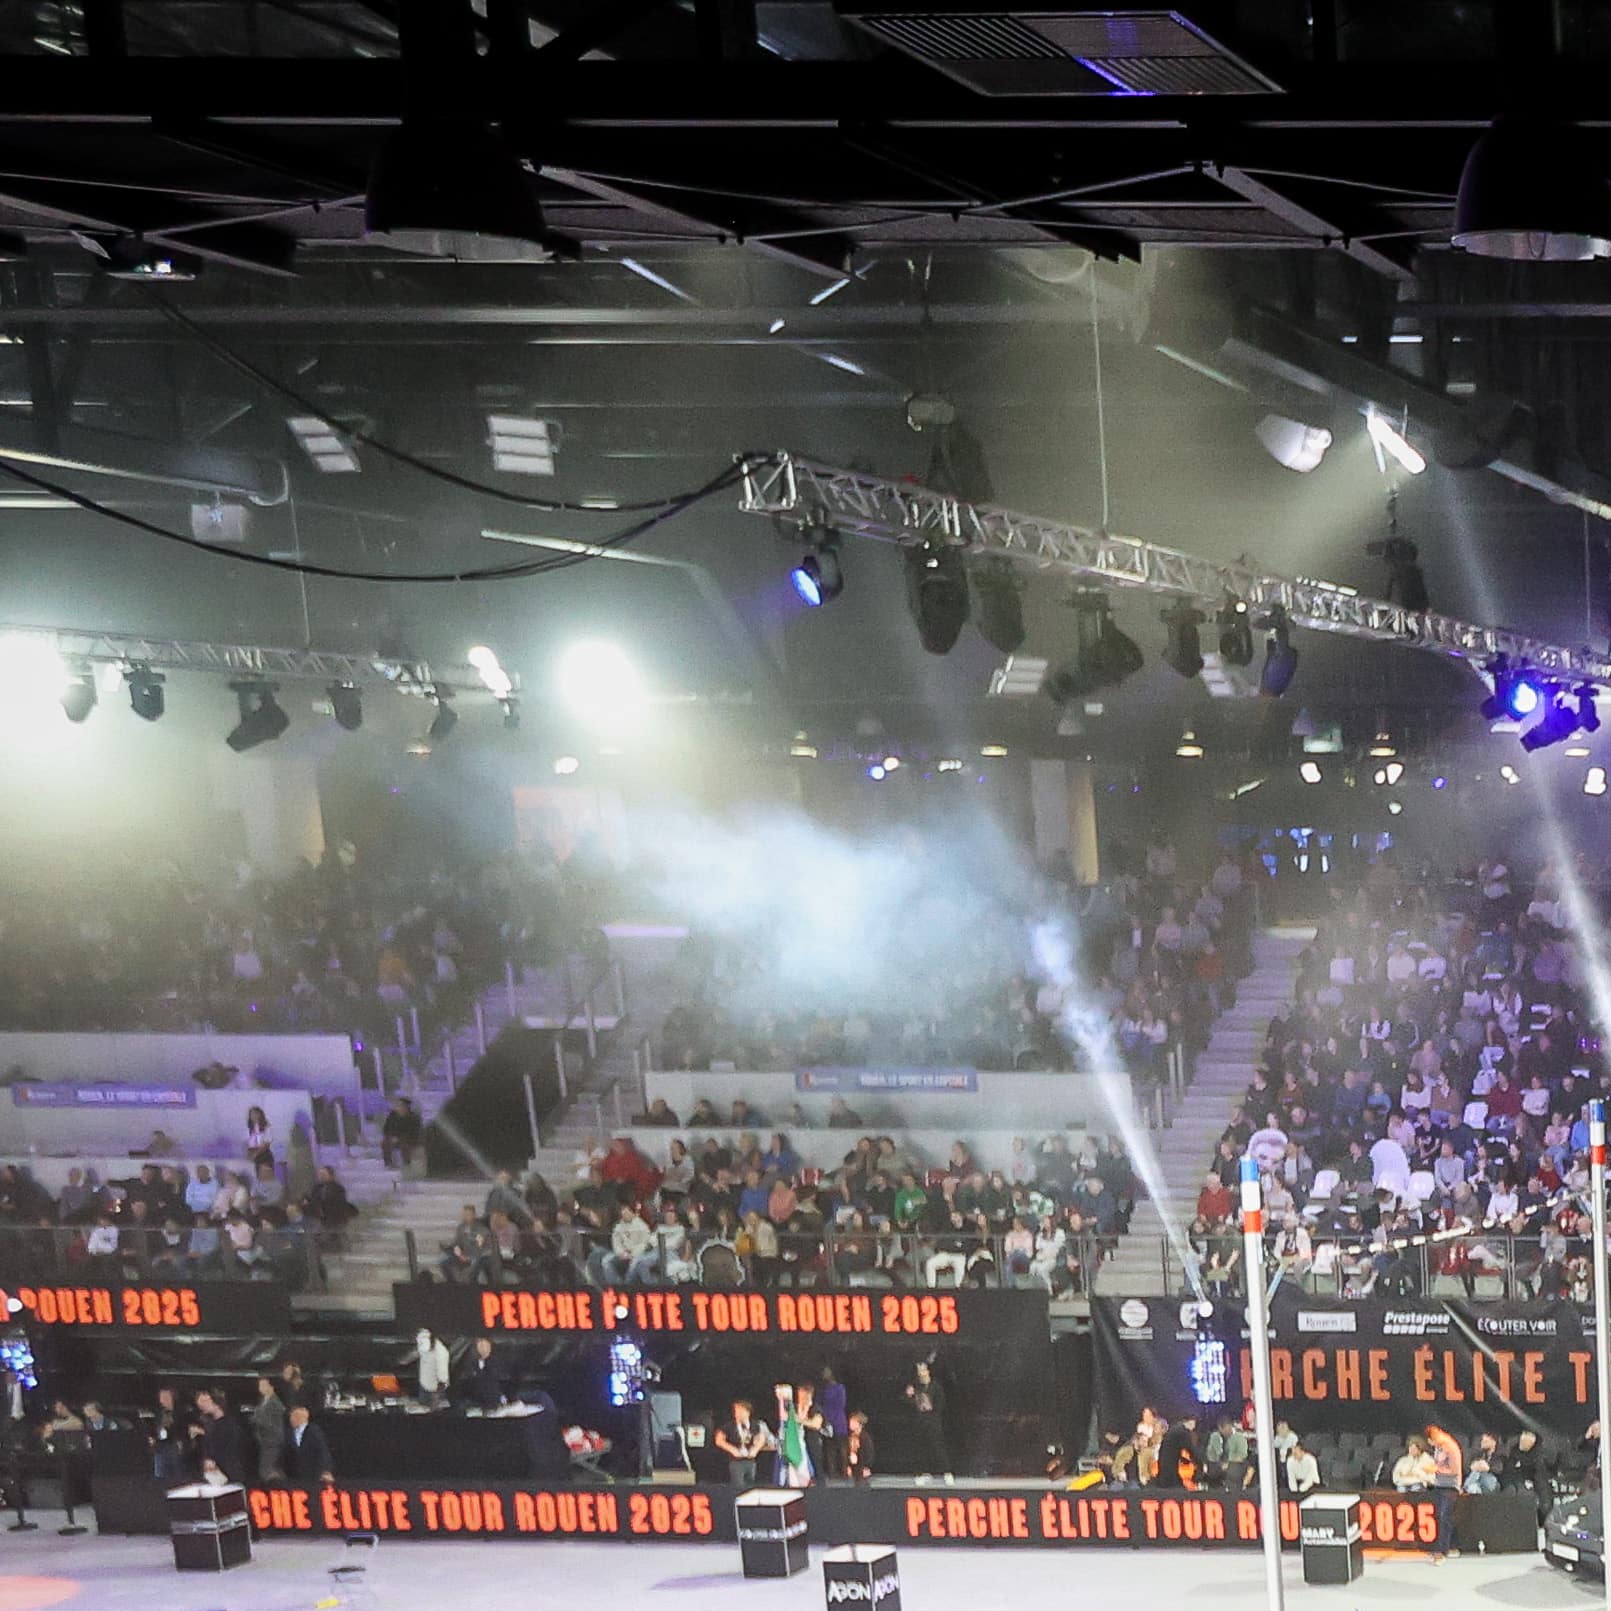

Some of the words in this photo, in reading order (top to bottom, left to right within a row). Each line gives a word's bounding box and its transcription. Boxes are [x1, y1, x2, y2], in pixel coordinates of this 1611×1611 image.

[122, 1289, 200, 1325] 2025
[481, 1291, 593, 1330] PERCHE
[693, 1293, 767, 1331] TOUR
[777, 1294, 872, 1333] ROUEN
[882, 1295, 959, 1334] 2025
[1414, 1343, 1546, 1404] ÉLITE
[321, 1485, 412, 1531] ÉLITE
[421, 1491, 505, 1532] TOUR
[514, 1492, 619, 1533] ROUEN
[629, 1494, 713, 1535] 2025
[906, 1497, 1029, 1538] PERCHE
[1041, 1493, 1130, 1538] ÉLITE
[1140, 1499, 1225, 1540] TOUR
